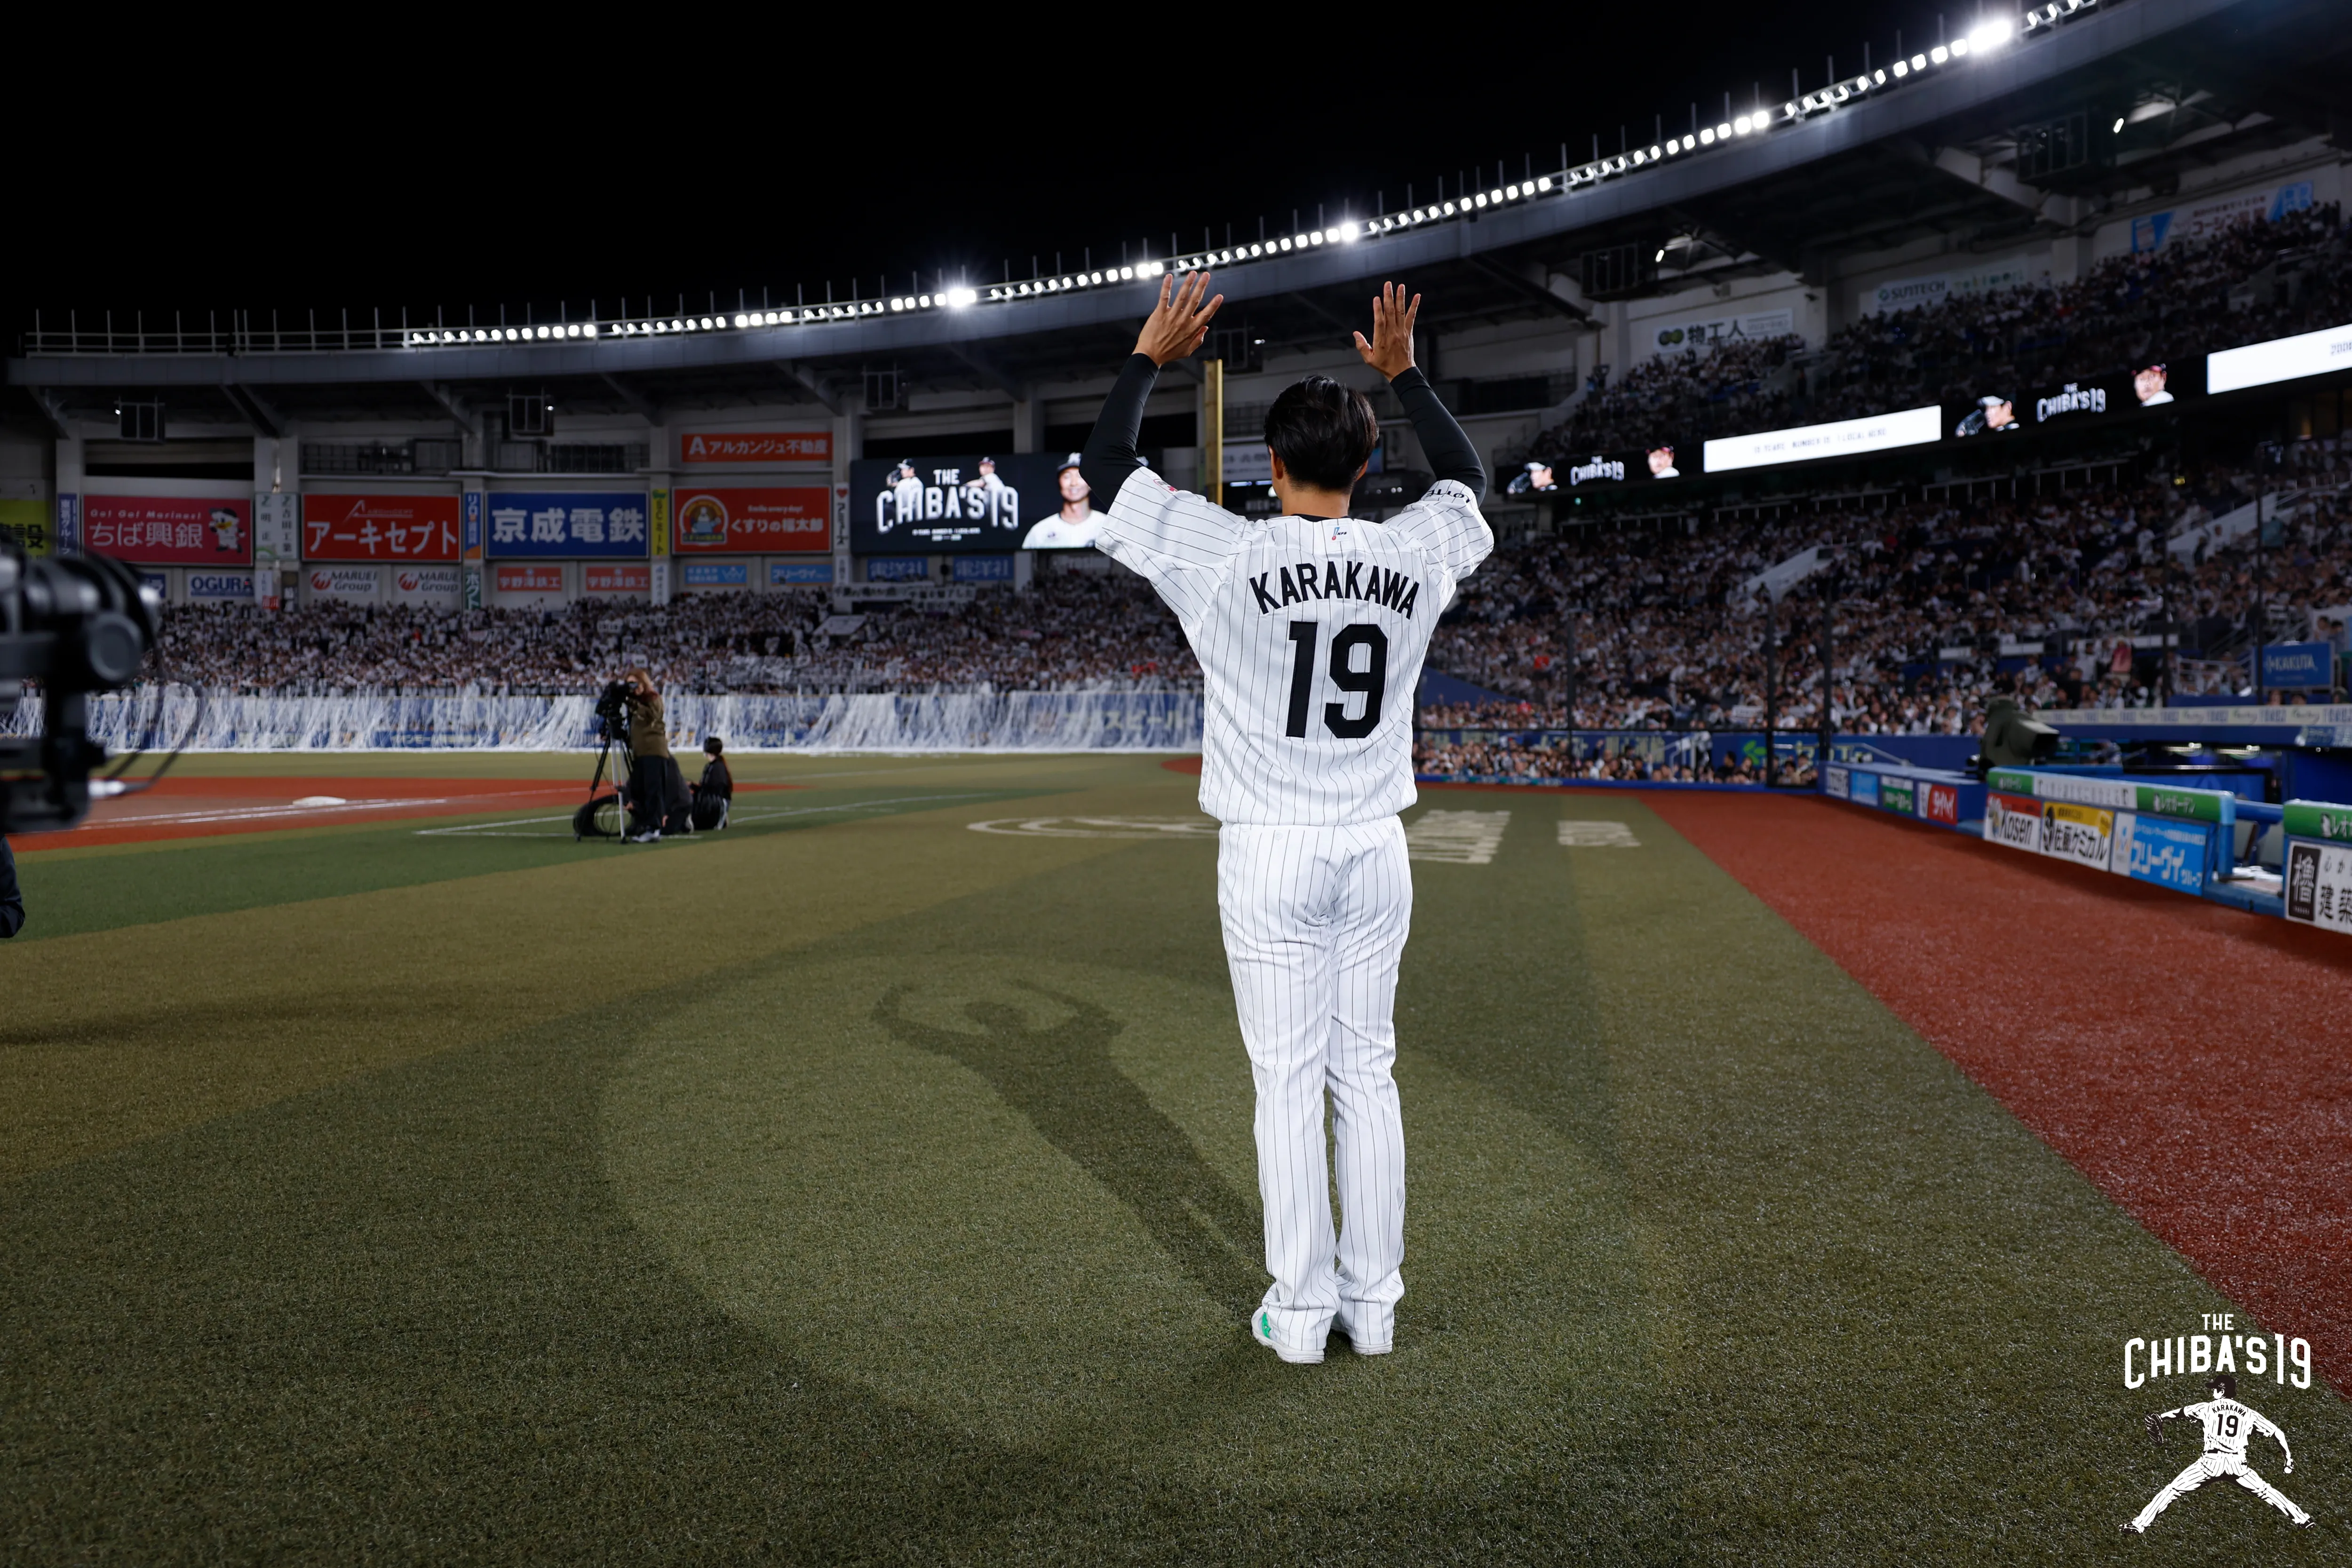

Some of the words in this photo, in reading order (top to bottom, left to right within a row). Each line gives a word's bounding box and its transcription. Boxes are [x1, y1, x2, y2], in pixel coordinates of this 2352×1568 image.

[933, 469, 960, 485] THE
[88, 521, 203, 549] ちば興銀
[492, 507, 644, 543] 京成電鉄
[731, 517, 823, 533] くすりの福太郎
[307, 519, 457, 555] アーキセプト
[191, 577, 254, 590] OGURA
[334, 581, 372, 592] Group
[421, 582, 459, 592] Group
[1249, 561, 1420, 619] KARAKAWA
[1286, 621, 1388, 739] 19
[2332, 814, 2352, 837] レオ
